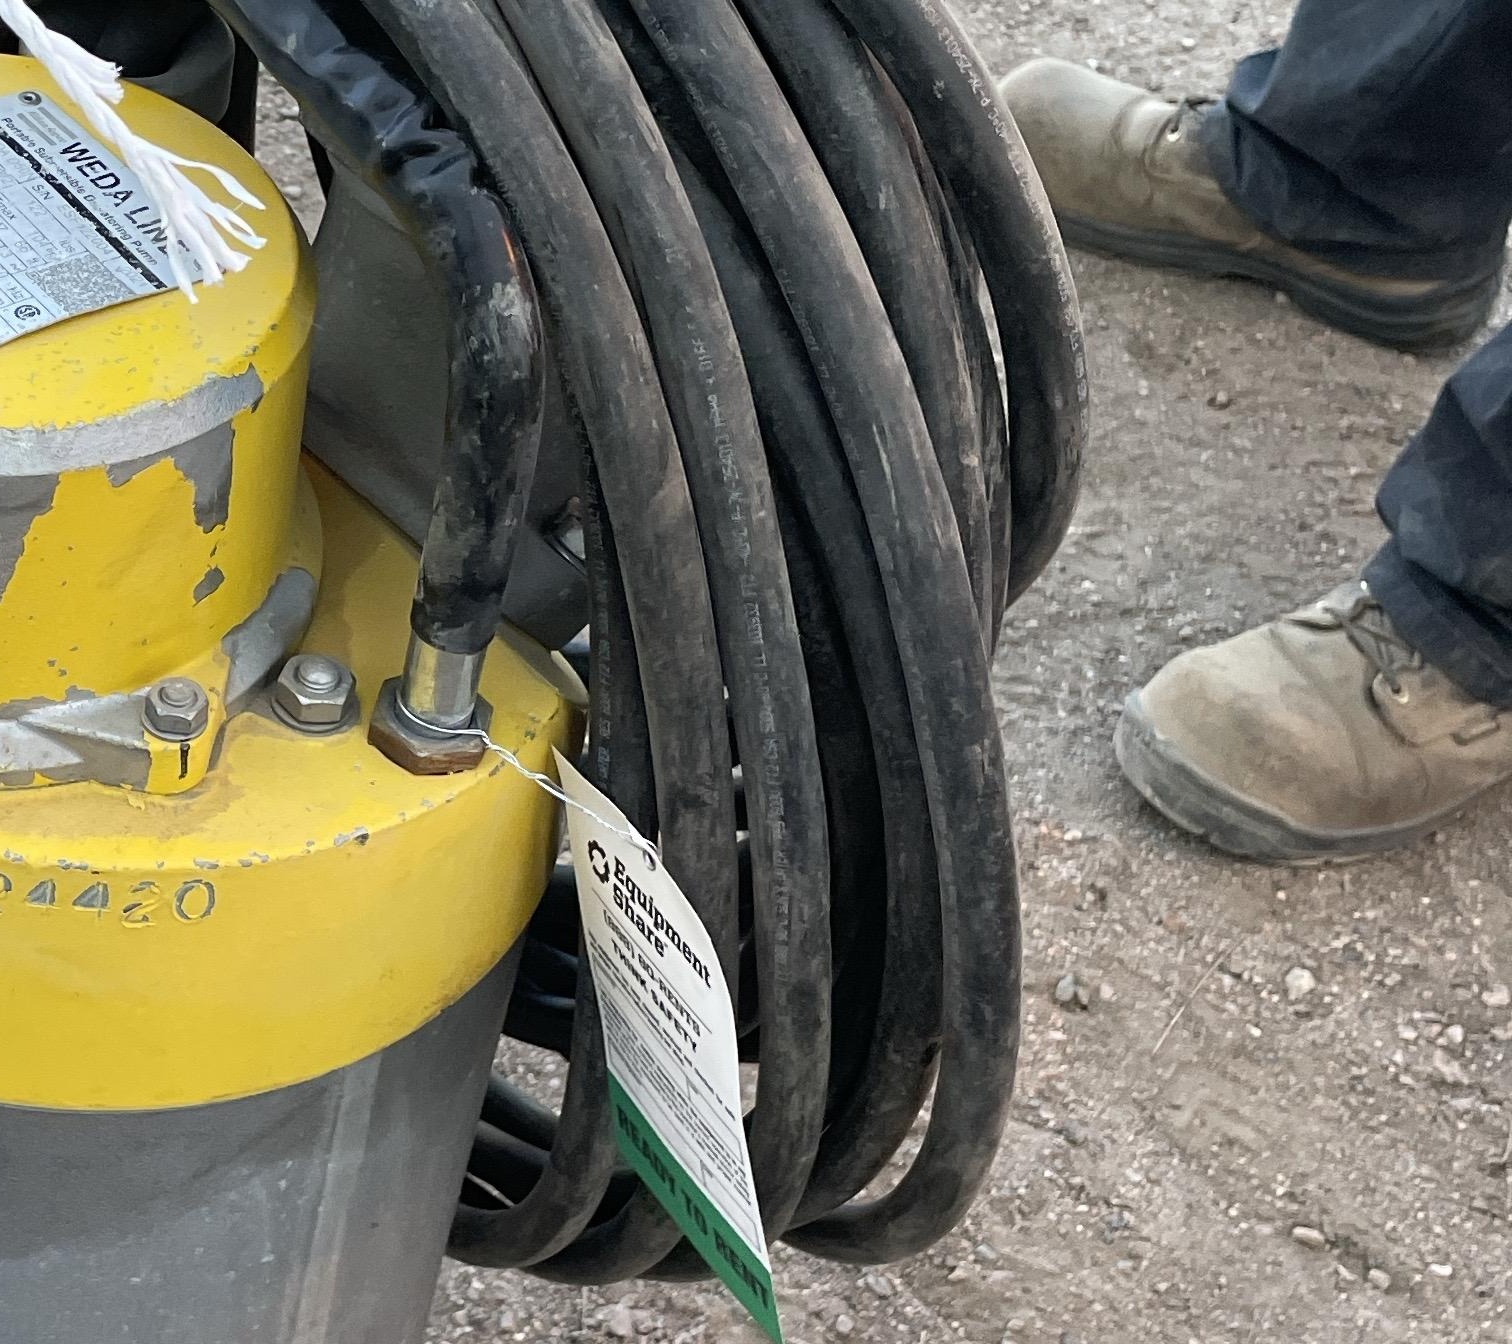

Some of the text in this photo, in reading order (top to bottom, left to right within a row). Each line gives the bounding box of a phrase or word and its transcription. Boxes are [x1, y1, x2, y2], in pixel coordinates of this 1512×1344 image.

[58, 141, 130, 207] WEDA
[127, 239, 162, 266] Pump
[613, 882, 666, 958] Share
[614, 855, 712, 989] Equipment
[612, 937, 698, 1053] THINK SAFETY
[682, 1188, 708, 1236] TO
[713, 1227, 768, 1308] RENT
